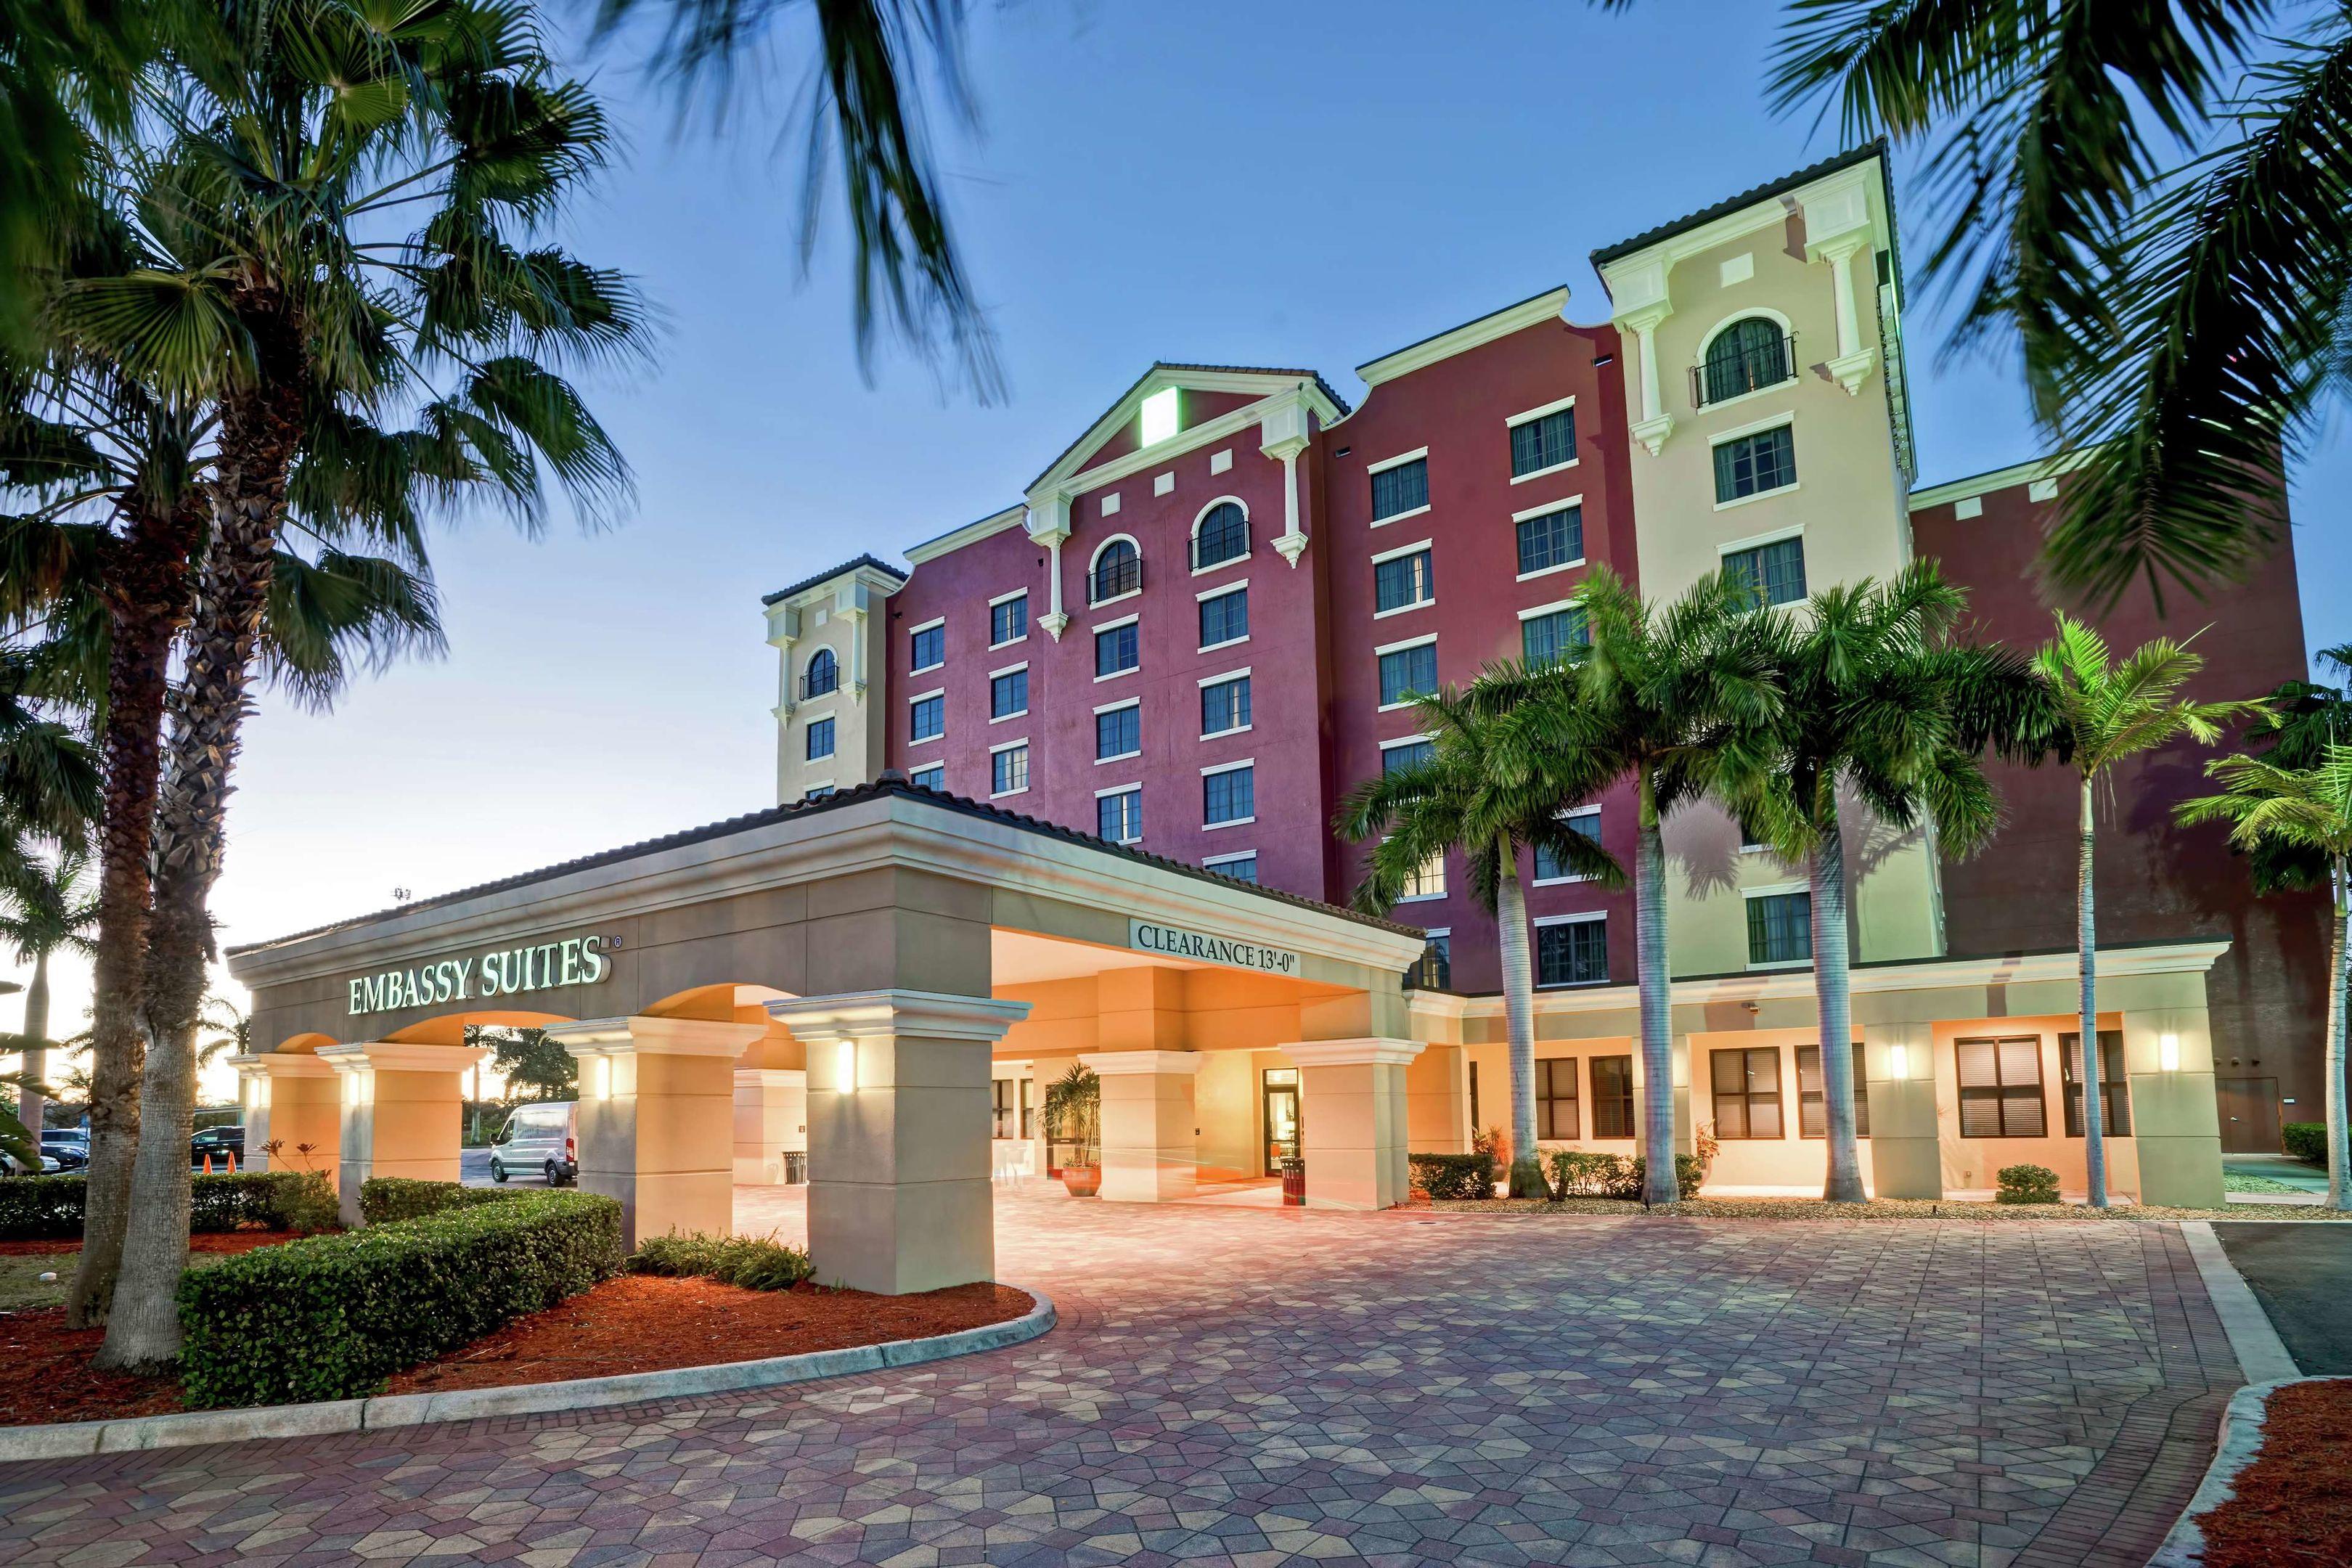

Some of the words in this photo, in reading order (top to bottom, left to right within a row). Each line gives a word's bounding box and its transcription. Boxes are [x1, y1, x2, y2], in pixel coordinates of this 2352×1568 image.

[348, 957, 474, 1015] EMBASSY
[481, 936, 605, 997] SUITES
[1138, 925, 1254, 966] CLEARANCE
